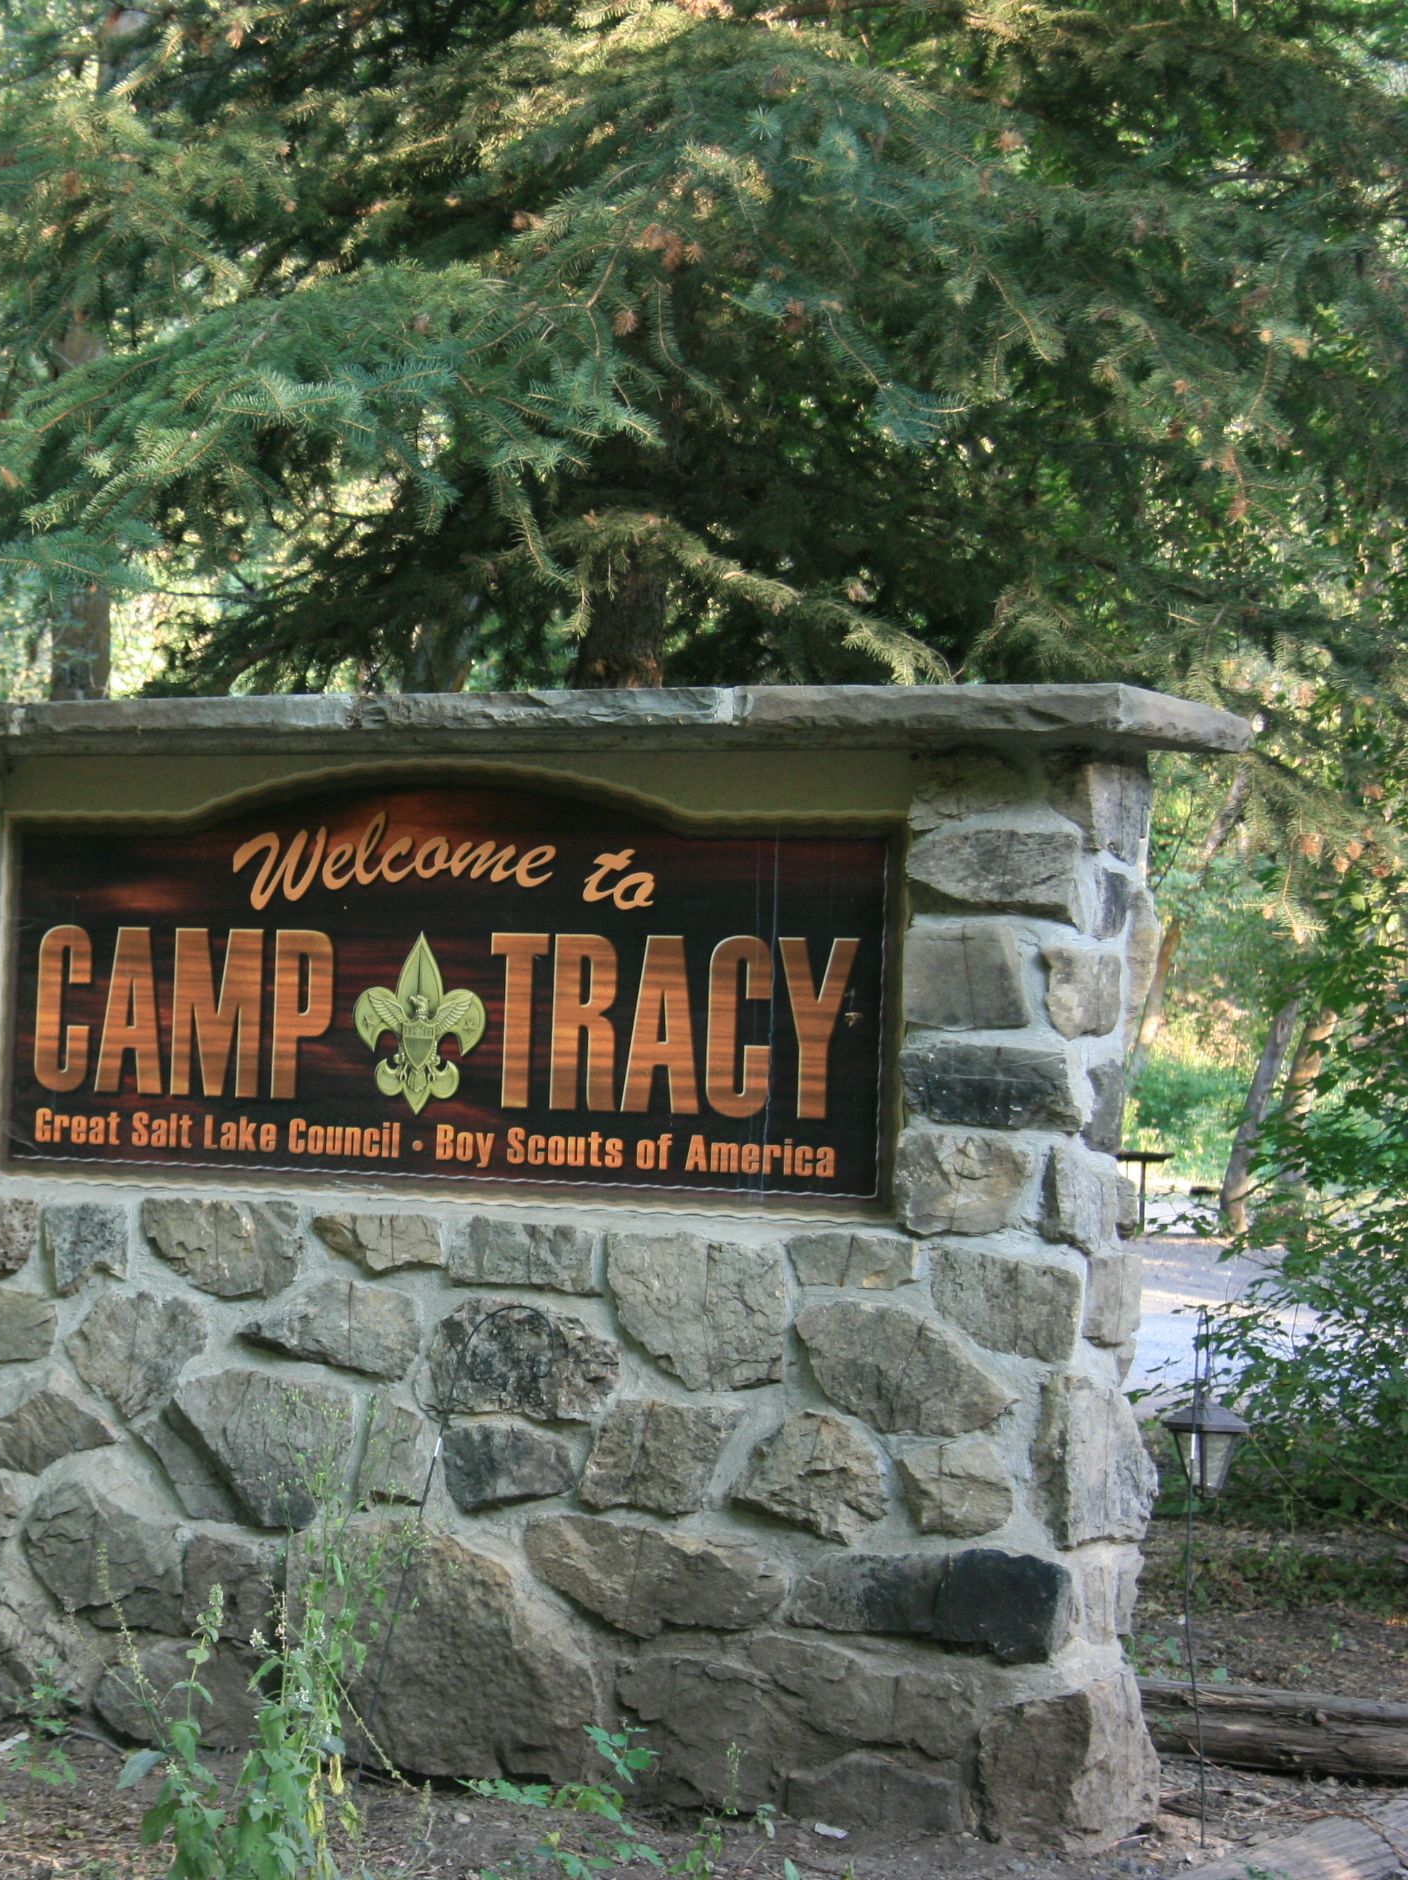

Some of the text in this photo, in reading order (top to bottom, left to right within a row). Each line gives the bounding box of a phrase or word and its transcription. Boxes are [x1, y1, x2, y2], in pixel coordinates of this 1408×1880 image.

[232, 811, 657, 911] Welcome to
[33, 924, 862, 1120] CAMP TRACY
[34, 1107, 836, 1178] Great Salt Lake Council Boy Scouts of America
